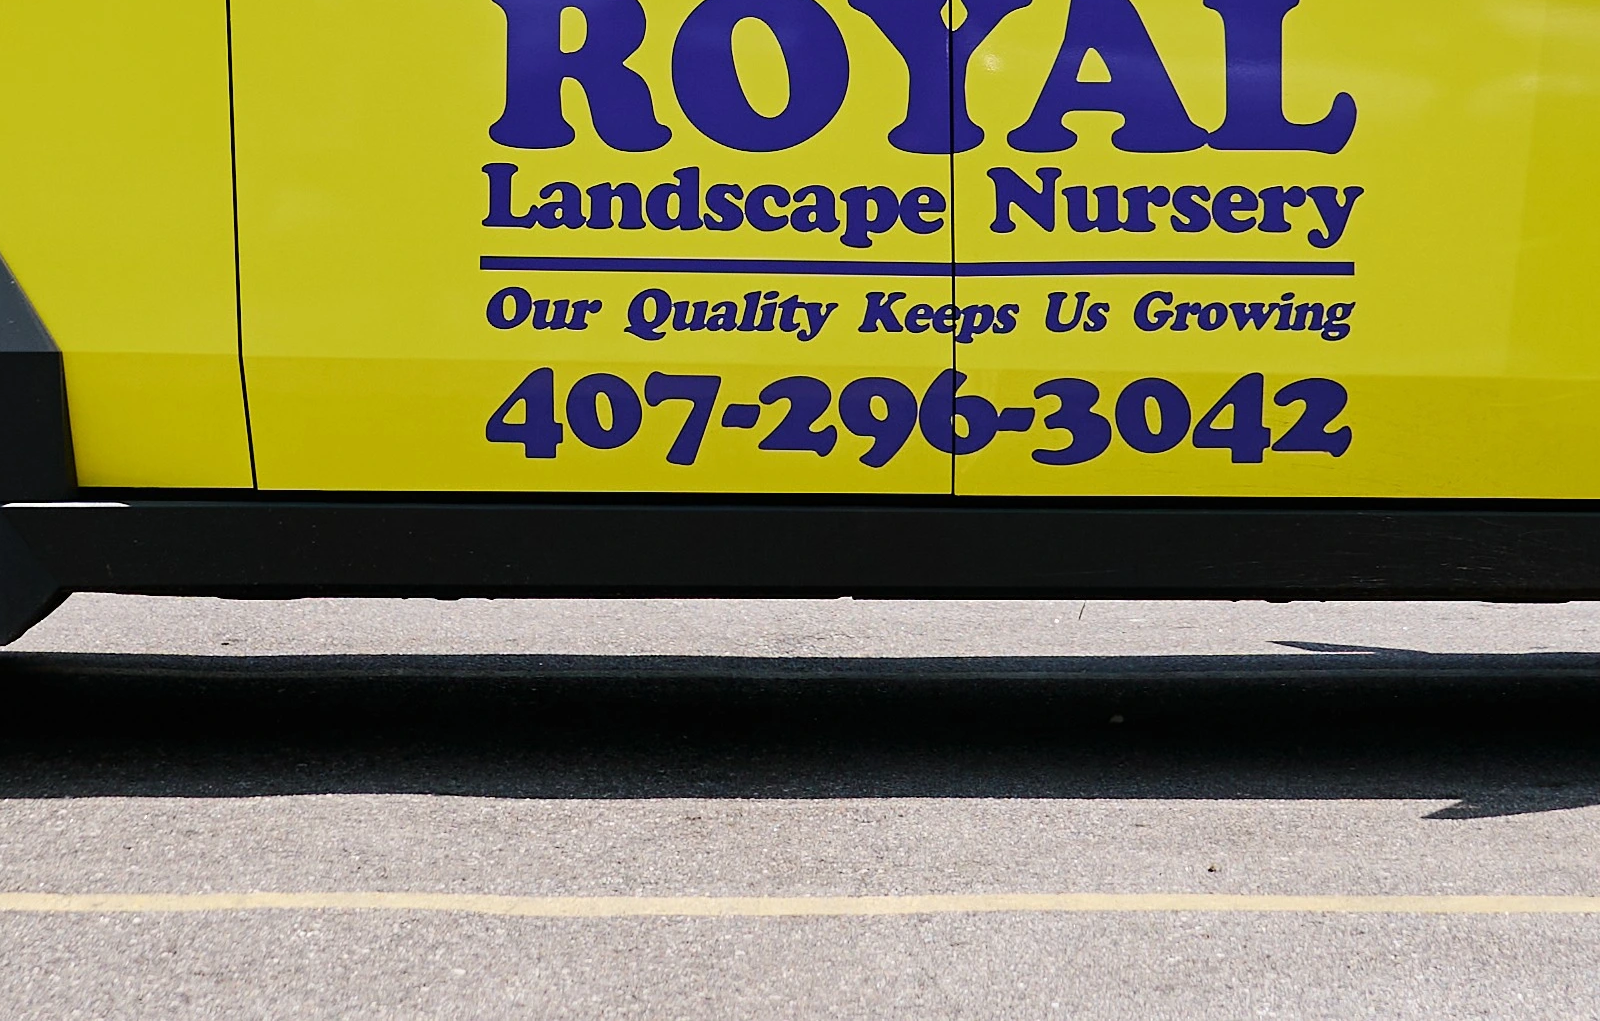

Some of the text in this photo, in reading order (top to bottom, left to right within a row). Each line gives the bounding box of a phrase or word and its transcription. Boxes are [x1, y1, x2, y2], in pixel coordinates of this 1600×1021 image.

[481, 162, 1364, 249] Landscape Nursery
[486, 286, 1357, 343] Our Quality Keeps Us Growing
[485, 367, 1353, 467] 407-296-3042
